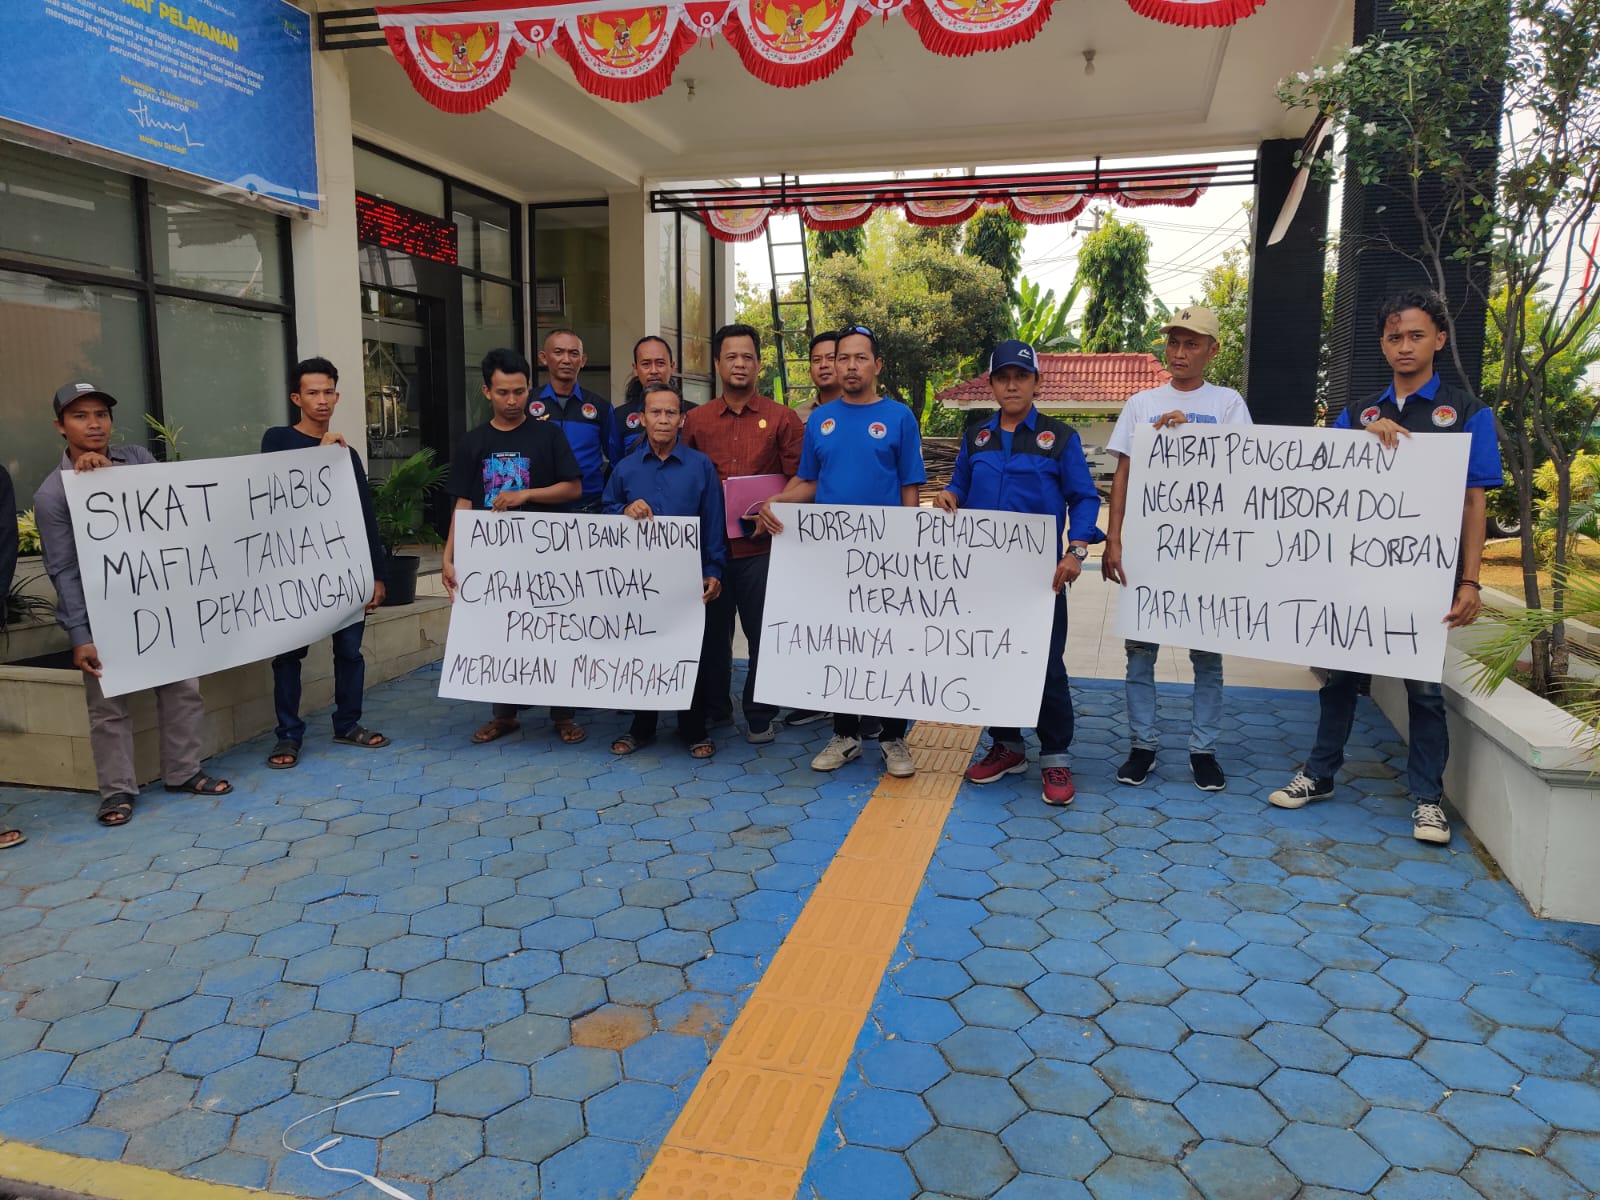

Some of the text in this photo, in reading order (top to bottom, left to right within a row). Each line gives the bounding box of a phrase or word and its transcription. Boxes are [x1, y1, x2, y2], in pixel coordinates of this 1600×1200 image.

[94, 15, 134, 37] pelayanan
[135, 33, 153, 47] yang
[159, 2, 239, 52] PELAYANAN
[1148, 433, 1221, 469] AKIBAT
[86, 465, 332, 541] SIKAT HABIS
[1142, 481, 1225, 517] NEGARA
[470, 517, 699, 554] AUDIT SDM BANK MANDIRI
[797, 509, 1047, 554] KORBAN PEMALSUAN
[1156, 523, 1457, 569] RAKYAT JADI KORBAN
[103, 520, 351, 600] MAFIA TANAH
[846, 549, 972, 581] DOKUMEN
[133, 563, 367, 656] DI PEKALONGAN
[460, 567, 660, 609] CARA KERJA TIDAK
[506, 610, 658, 645] PROFESIONAL
[767, 621, 894, 659] TANAHNYA
[1135, 585, 1419, 655] PARA MAFIA TANAH
[449, 653, 699, 697] MERUGIKAN MASYARAKAT
